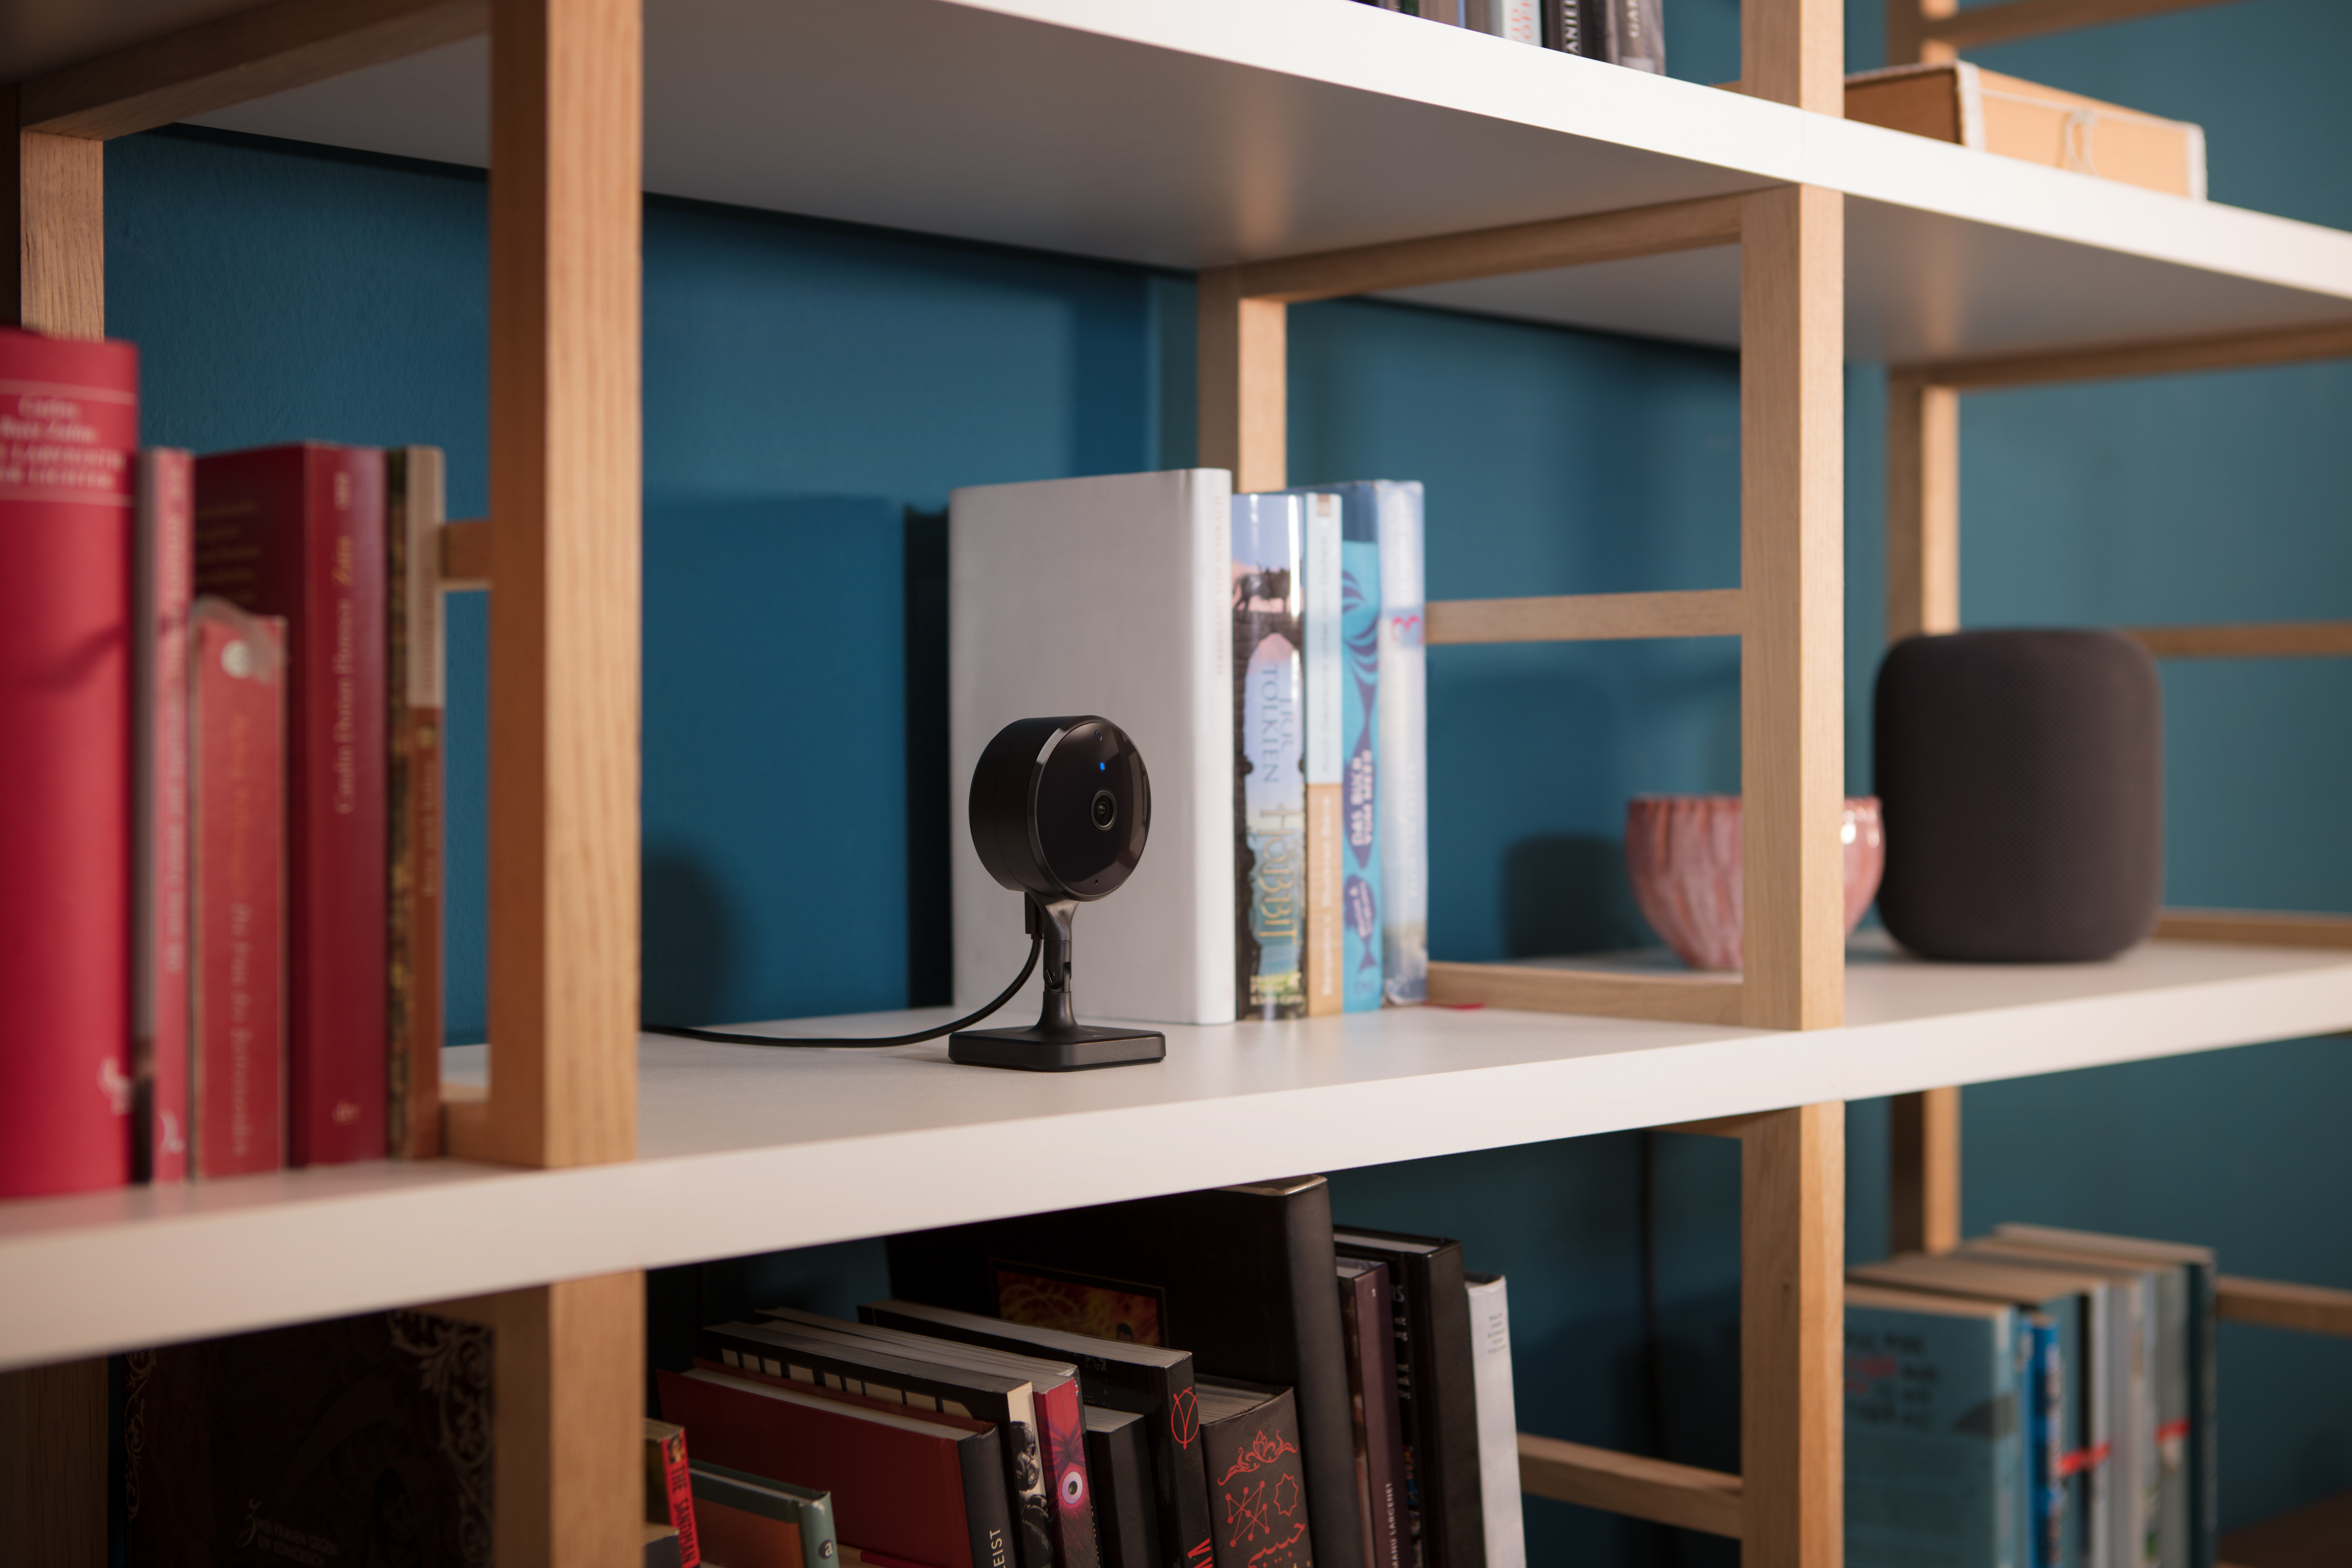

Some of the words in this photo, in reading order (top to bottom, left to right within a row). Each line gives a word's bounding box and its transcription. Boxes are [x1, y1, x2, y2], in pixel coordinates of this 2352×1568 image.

[1262, 663, 1279, 782] TOLKIEN
[1350, 757, 1363, 805] BUCH
[1350, 810, 1364, 846] DAS
[1258, 804, 1304, 946] HOBBIT
[671, 1465, 688, 1493] THE
[673, 1497, 696, 1564] SANDMAN
[990, 1529, 1005, 1568] EIST
[1390, 1538, 1400, 1568] MANU
